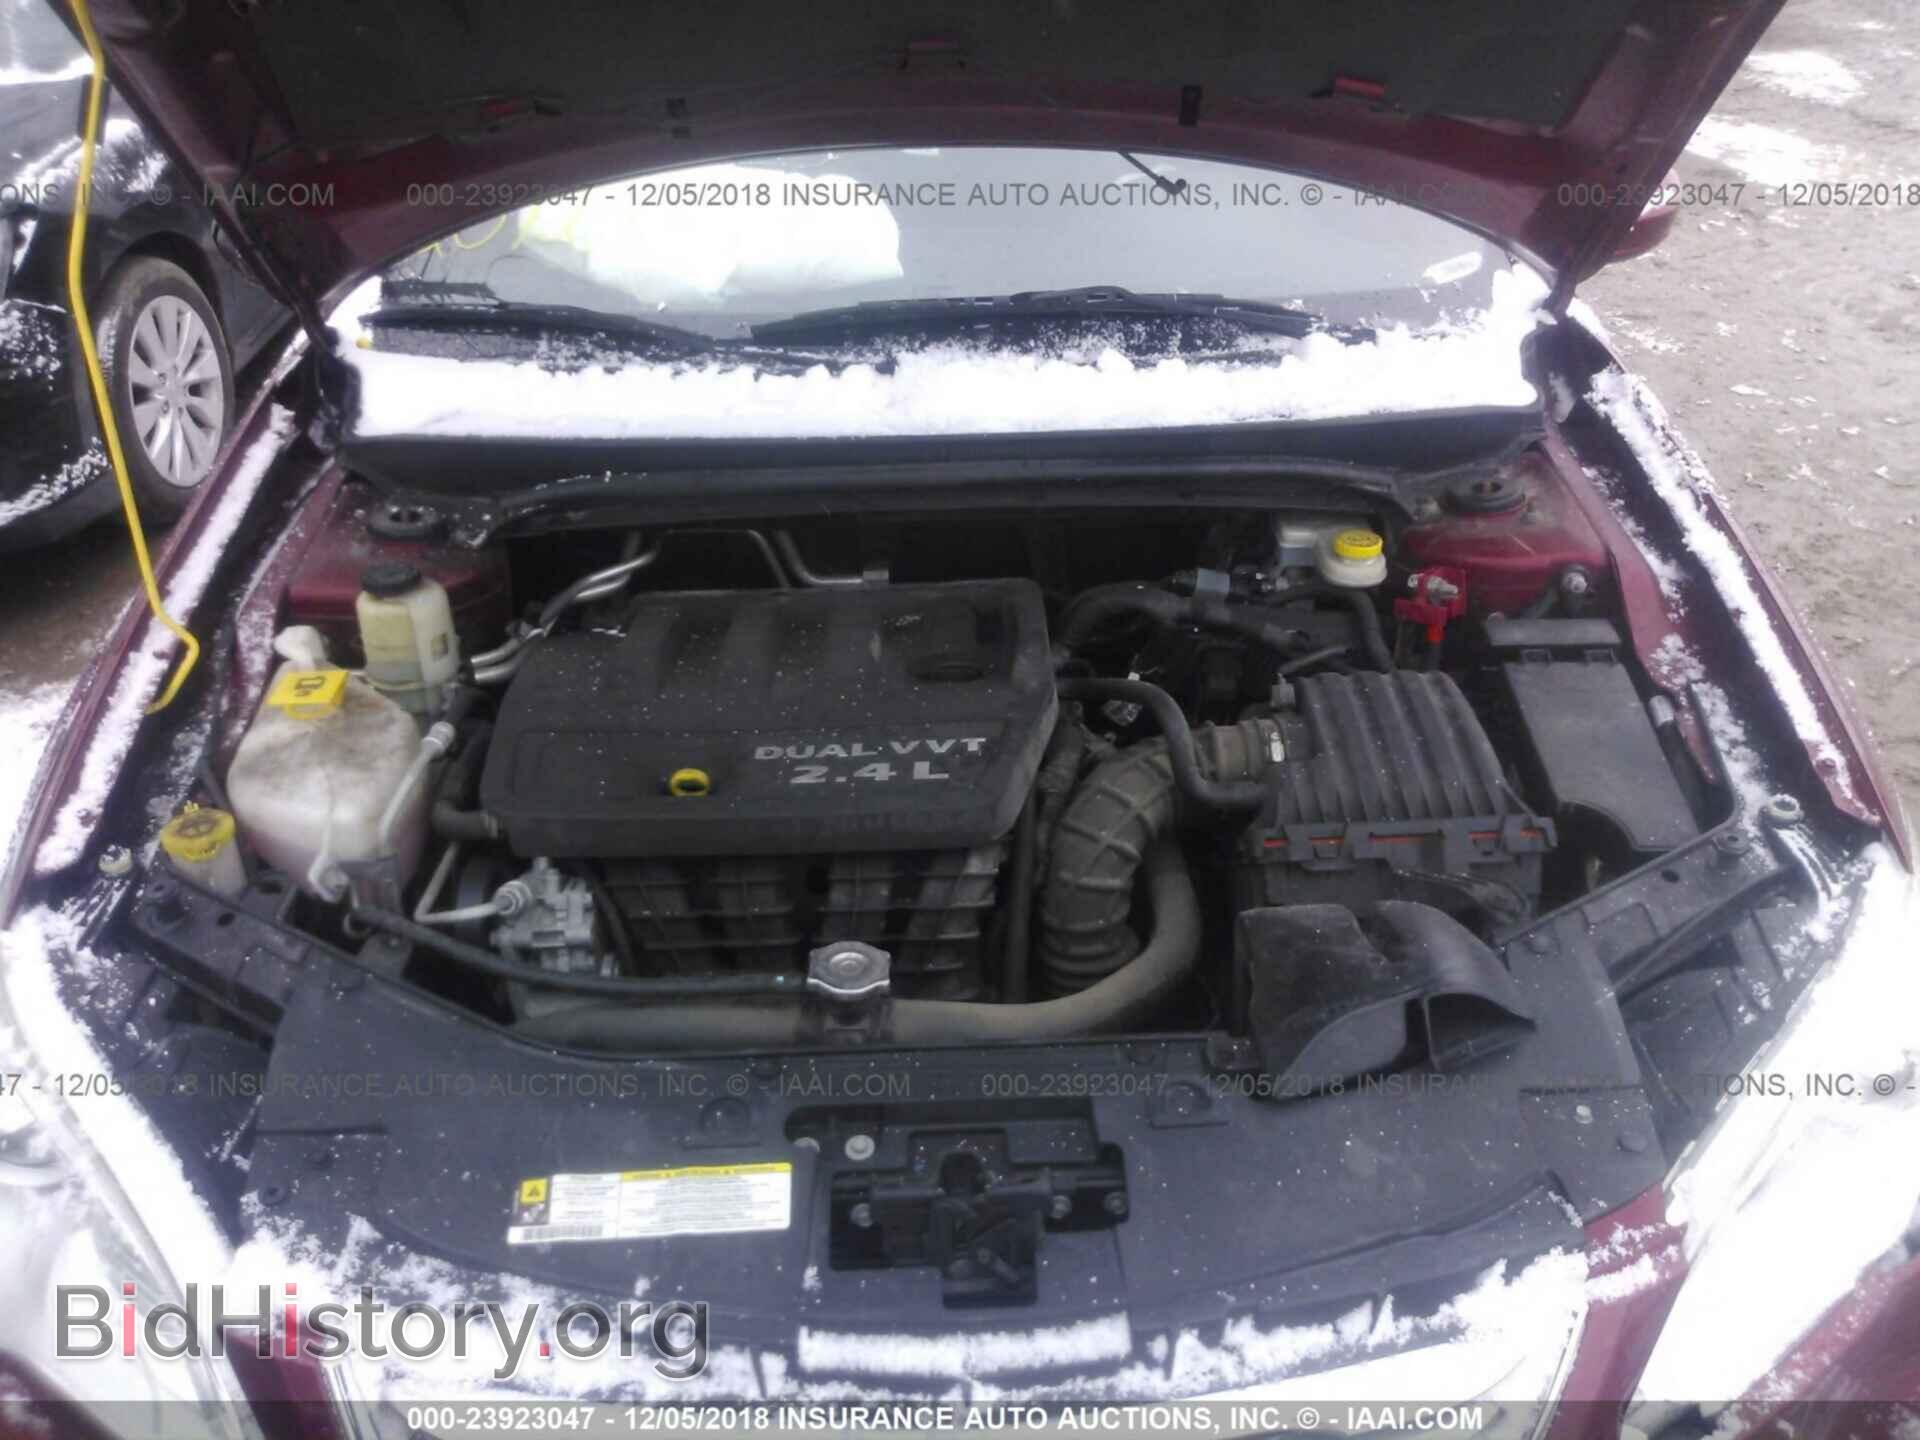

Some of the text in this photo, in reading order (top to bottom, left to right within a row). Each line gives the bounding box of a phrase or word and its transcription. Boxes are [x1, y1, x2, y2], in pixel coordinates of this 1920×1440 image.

[754, 737, 986, 759] DUAL VVT
[790, 761, 949, 783] 2.4 L
